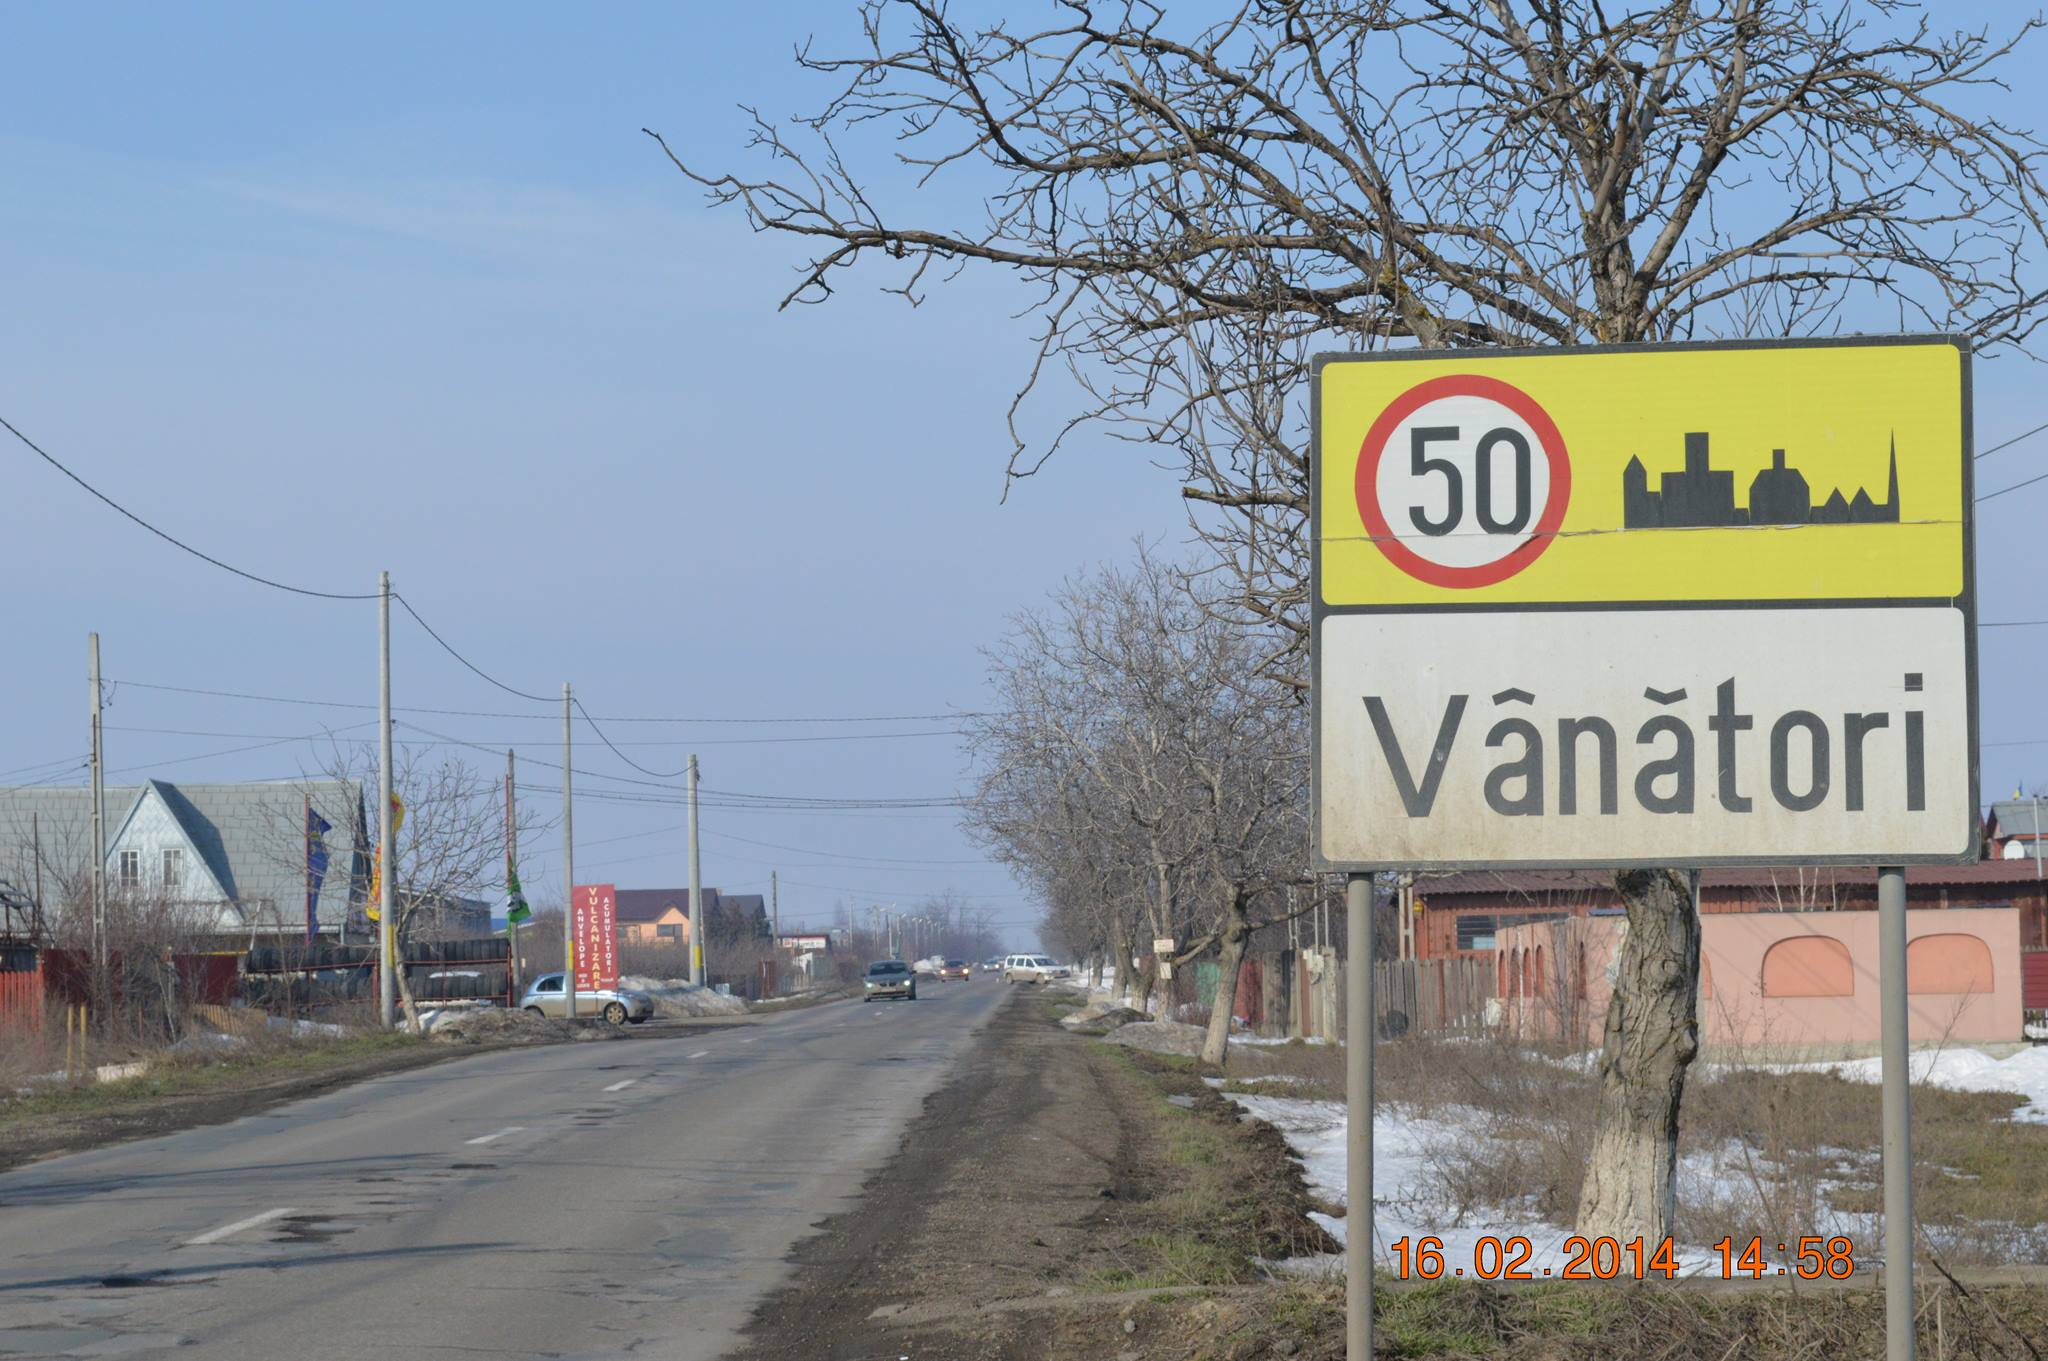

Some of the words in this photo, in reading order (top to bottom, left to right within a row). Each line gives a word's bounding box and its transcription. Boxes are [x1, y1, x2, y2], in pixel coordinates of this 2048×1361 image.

[1408, 426, 1532, 537] 50
[1362, 673, 1926, 819] Vânători
[577, 908, 586, 968] ANVELOPE
[589, 887, 600, 990] VULCANIZARE
[604, 897, 613, 973] ACUMULATORI
